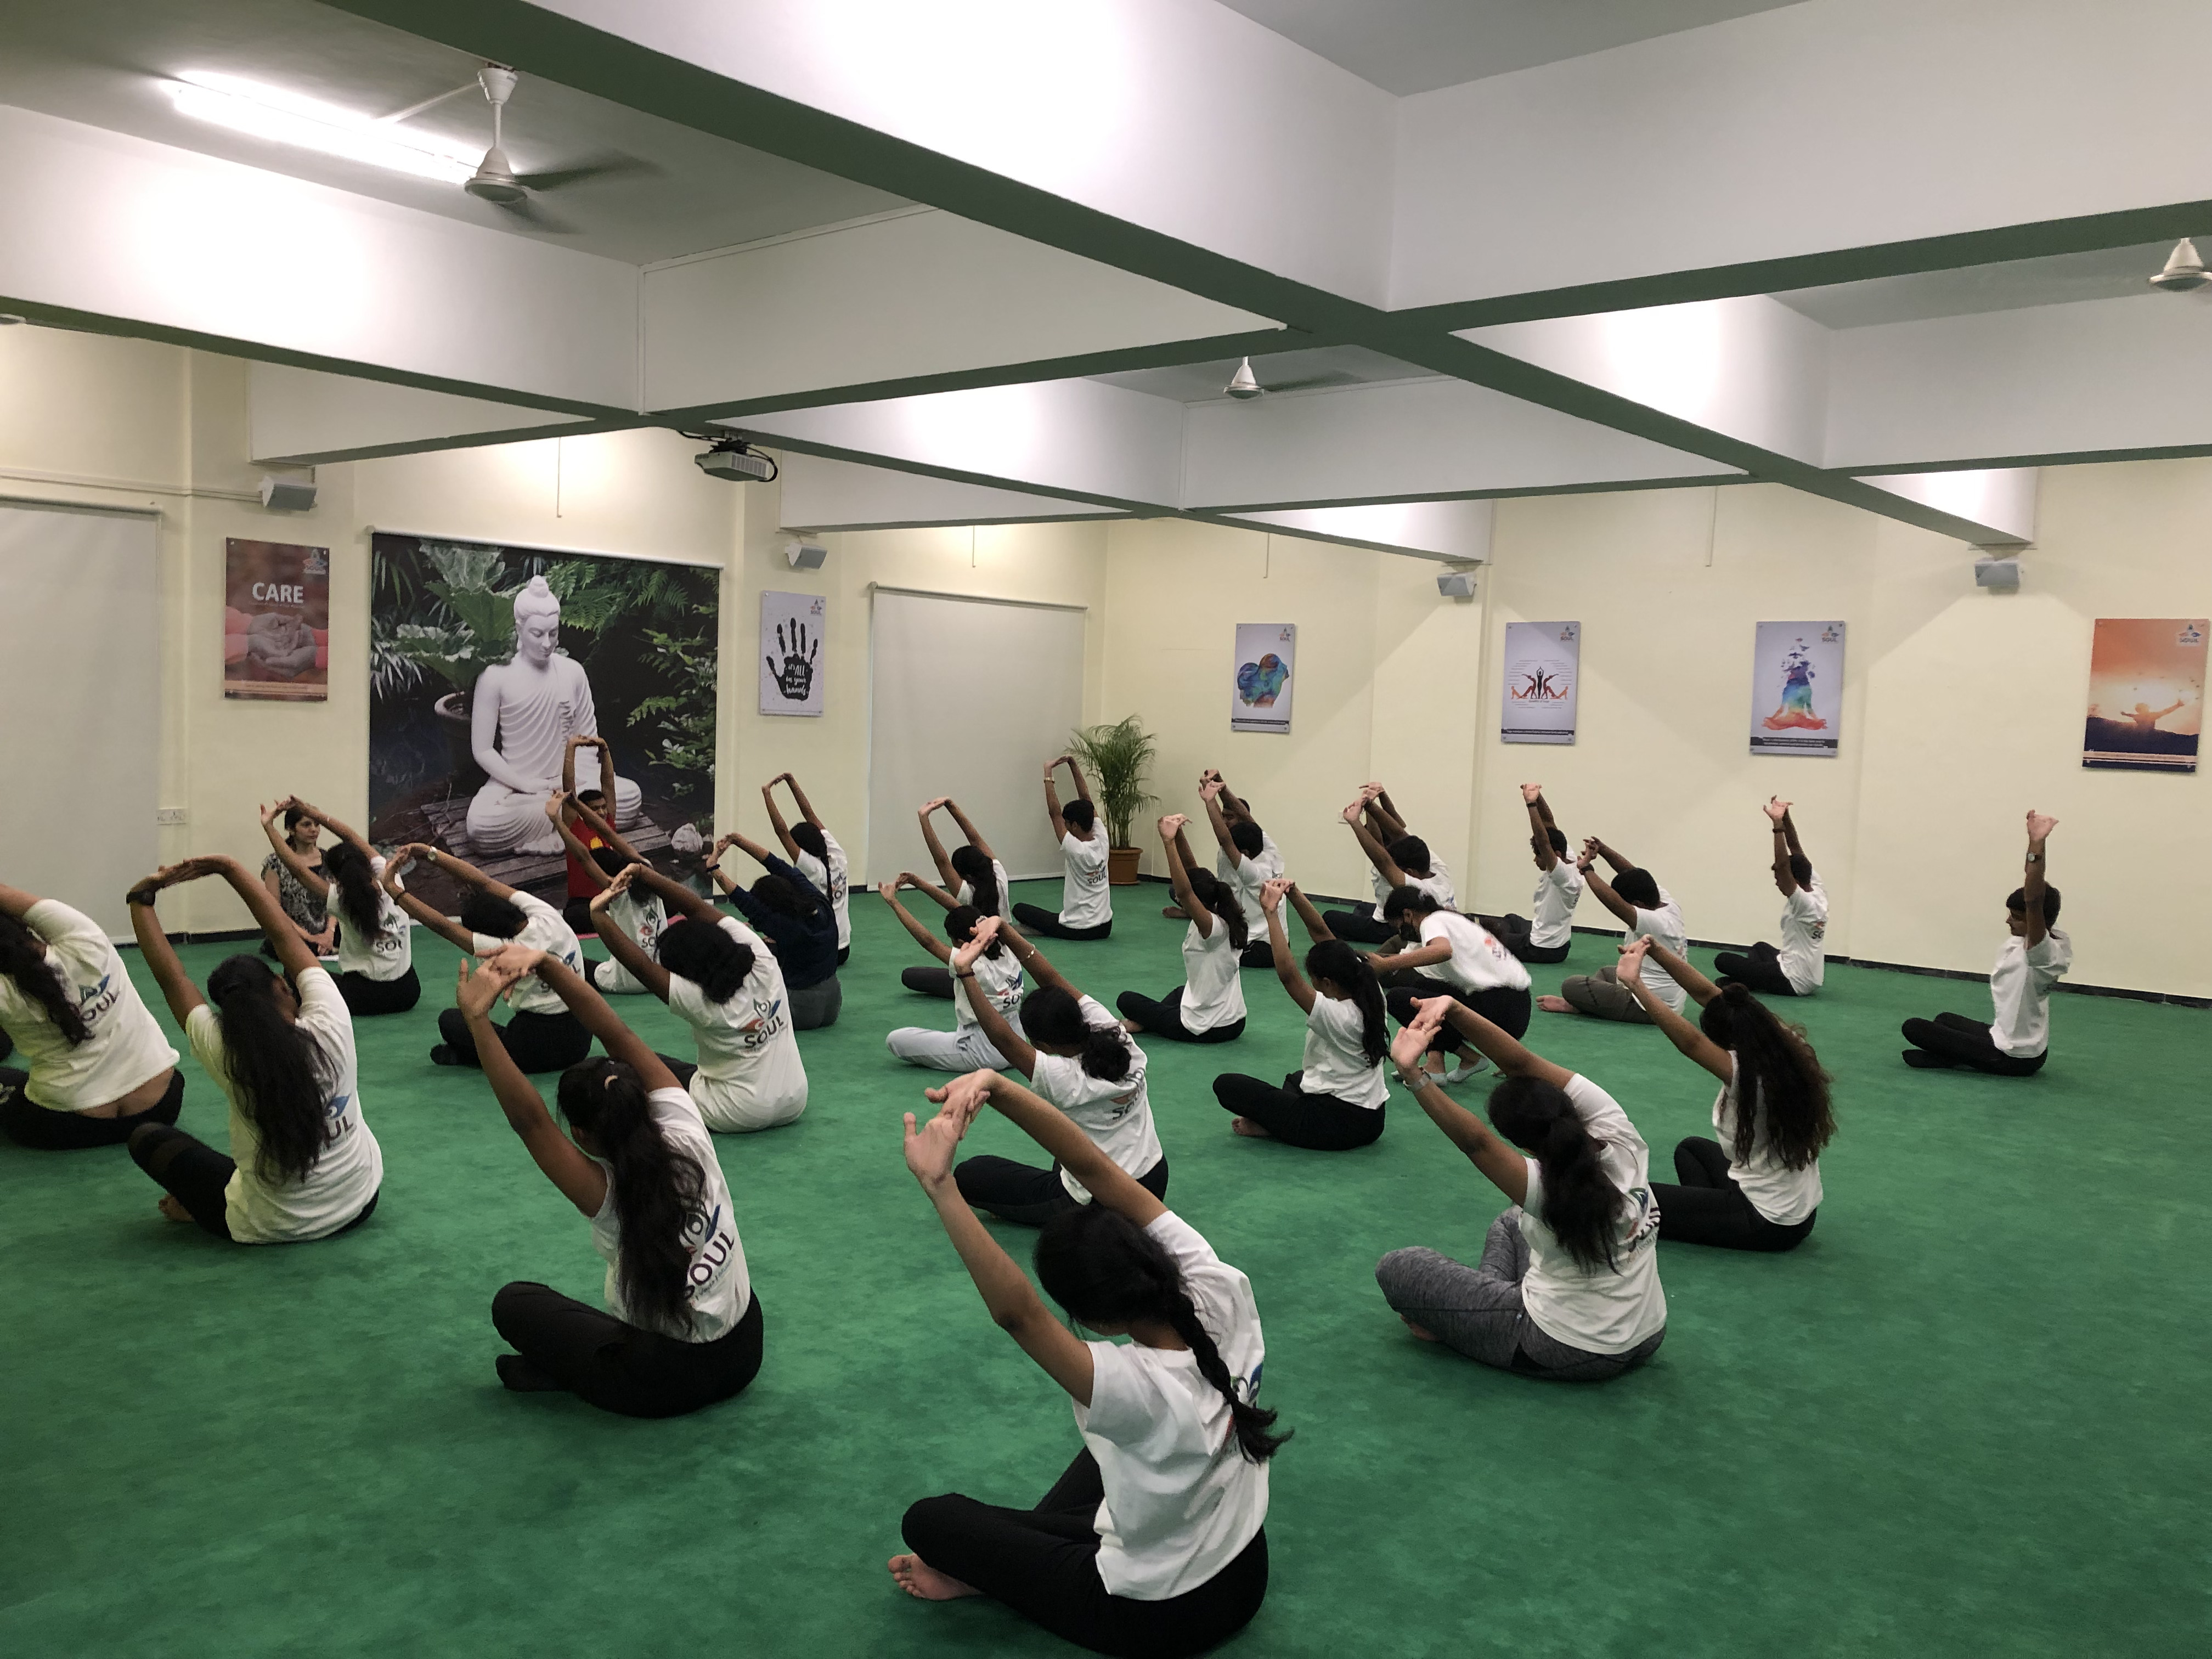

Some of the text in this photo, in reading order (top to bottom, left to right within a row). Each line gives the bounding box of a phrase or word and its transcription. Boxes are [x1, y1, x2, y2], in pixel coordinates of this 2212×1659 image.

[252, 582, 304, 603] CARE
[786, 684, 806, 696] hands
[80, 990, 120, 1022] OUL
[744, 1015, 785, 1049] SOUL
